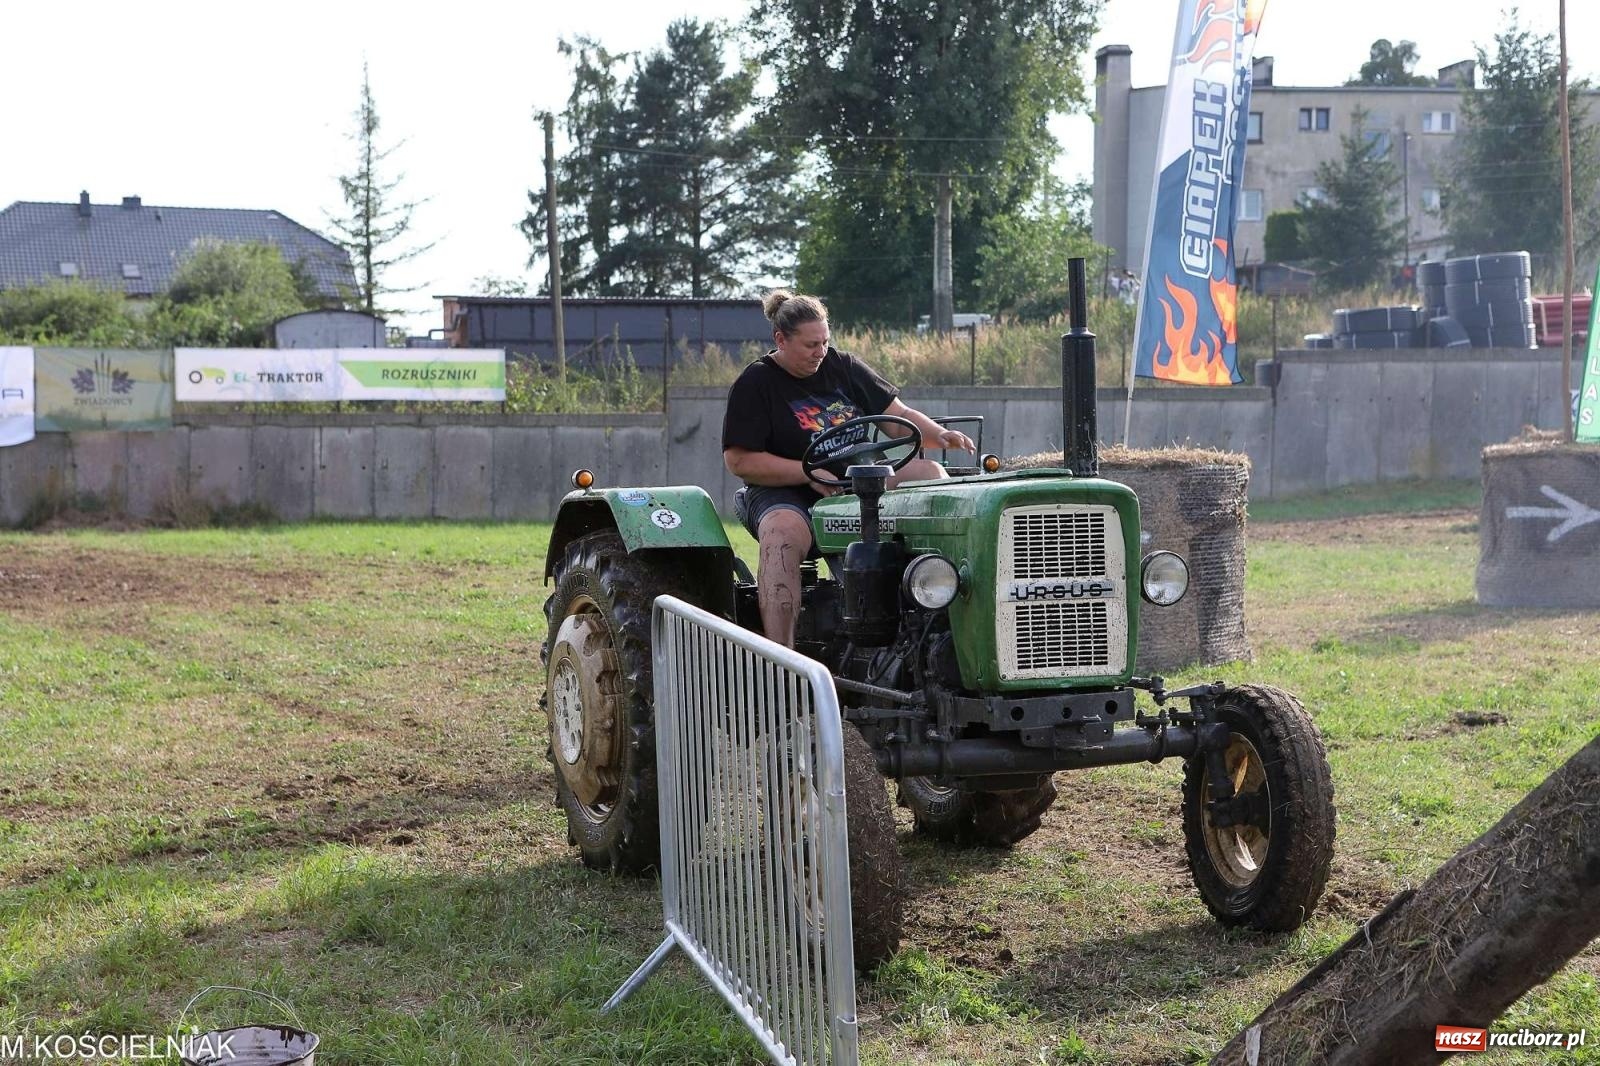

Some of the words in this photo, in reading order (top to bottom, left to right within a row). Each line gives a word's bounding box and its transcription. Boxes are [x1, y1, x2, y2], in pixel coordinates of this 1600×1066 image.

[1182, 79, 1227, 277] CIAPEK
[382, 368, 477, 381] ROZRUSZNIKI
[825, 519, 862, 532] URSUS
[1013, 583, 1108, 601] URSUS
